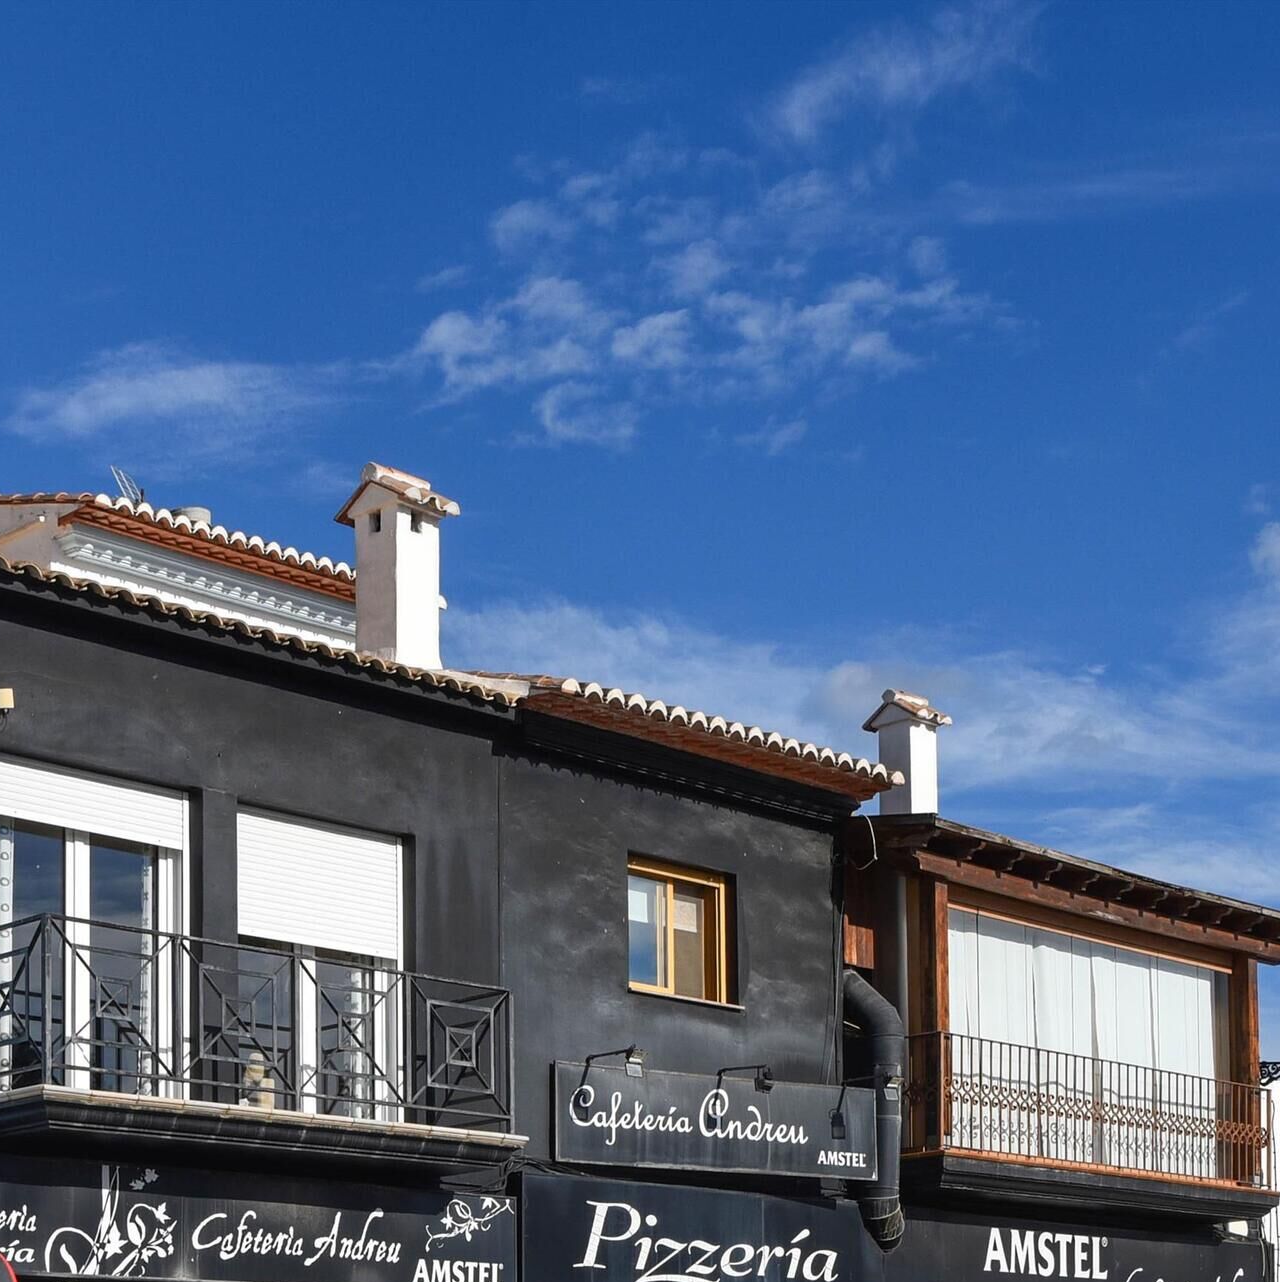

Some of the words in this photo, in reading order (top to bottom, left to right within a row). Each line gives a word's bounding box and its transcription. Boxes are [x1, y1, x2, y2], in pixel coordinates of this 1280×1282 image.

[569, 1085, 694, 1145] Cafetería
[699, 1090, 809, 1144] Andreu
[304, 1208, 401, 1266] Andreu
